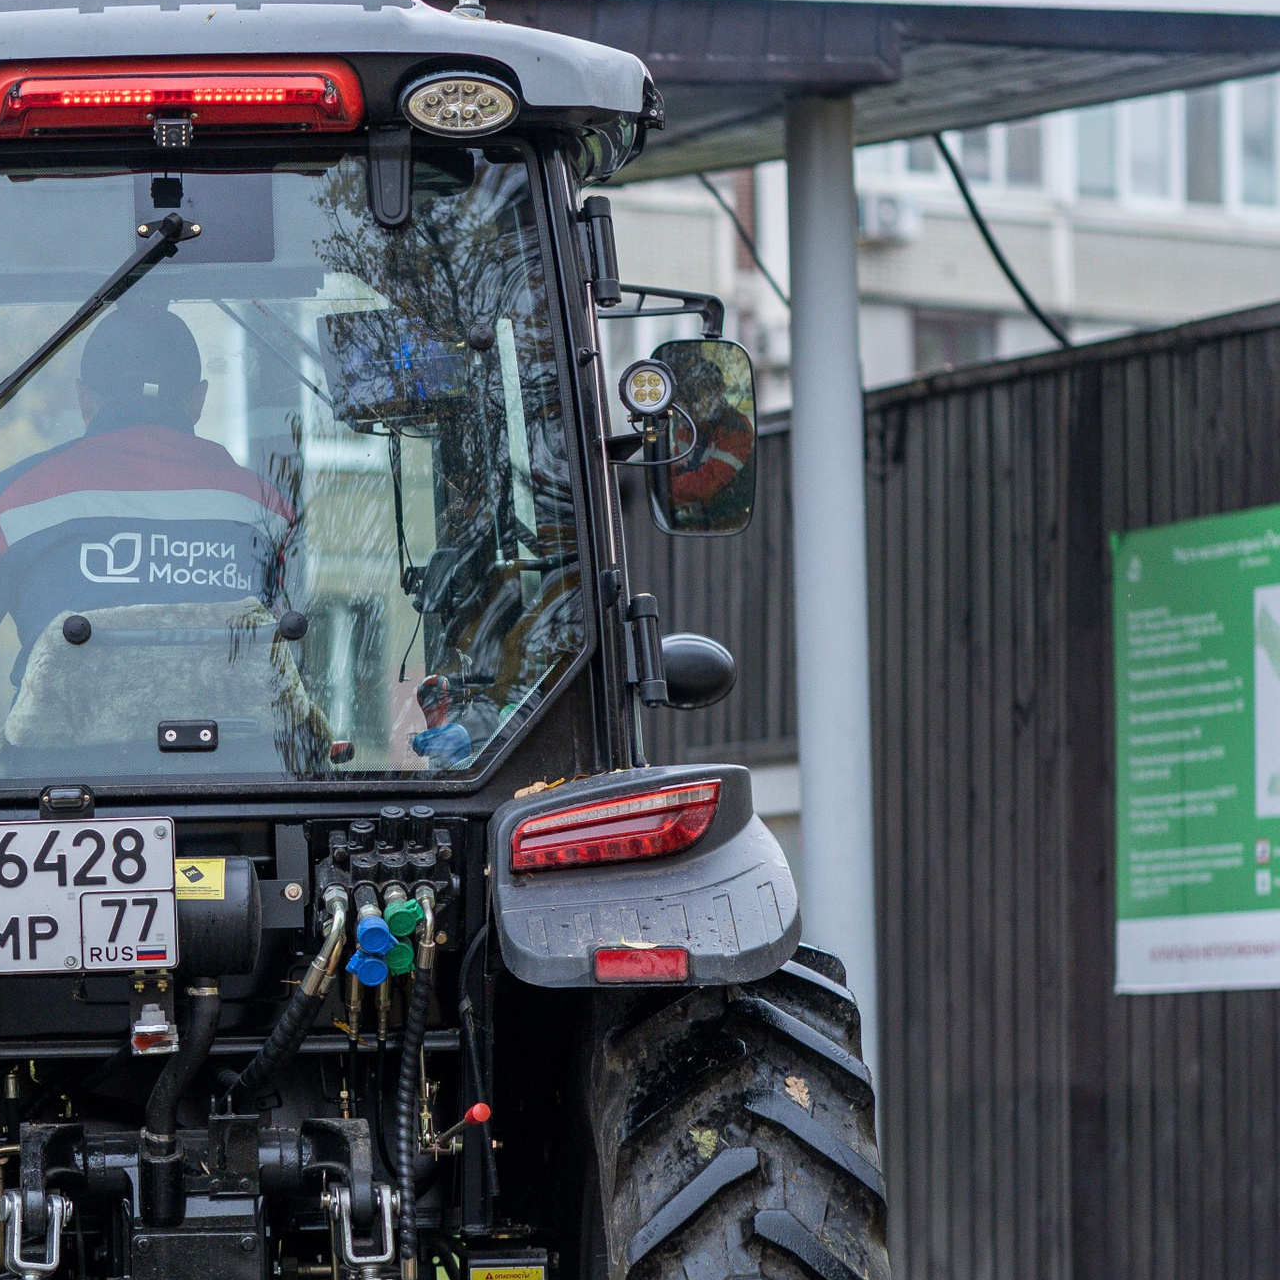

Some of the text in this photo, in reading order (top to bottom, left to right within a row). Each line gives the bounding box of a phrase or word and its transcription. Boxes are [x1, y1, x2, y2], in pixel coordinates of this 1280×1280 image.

[150, 533, 236, 567] Парки
[149, 562, 252, 591] Москвы
[185, 869, 199, 877] OIL
[100, 897, 158, 943] 77
[90, 945, 134, 963] RUS
